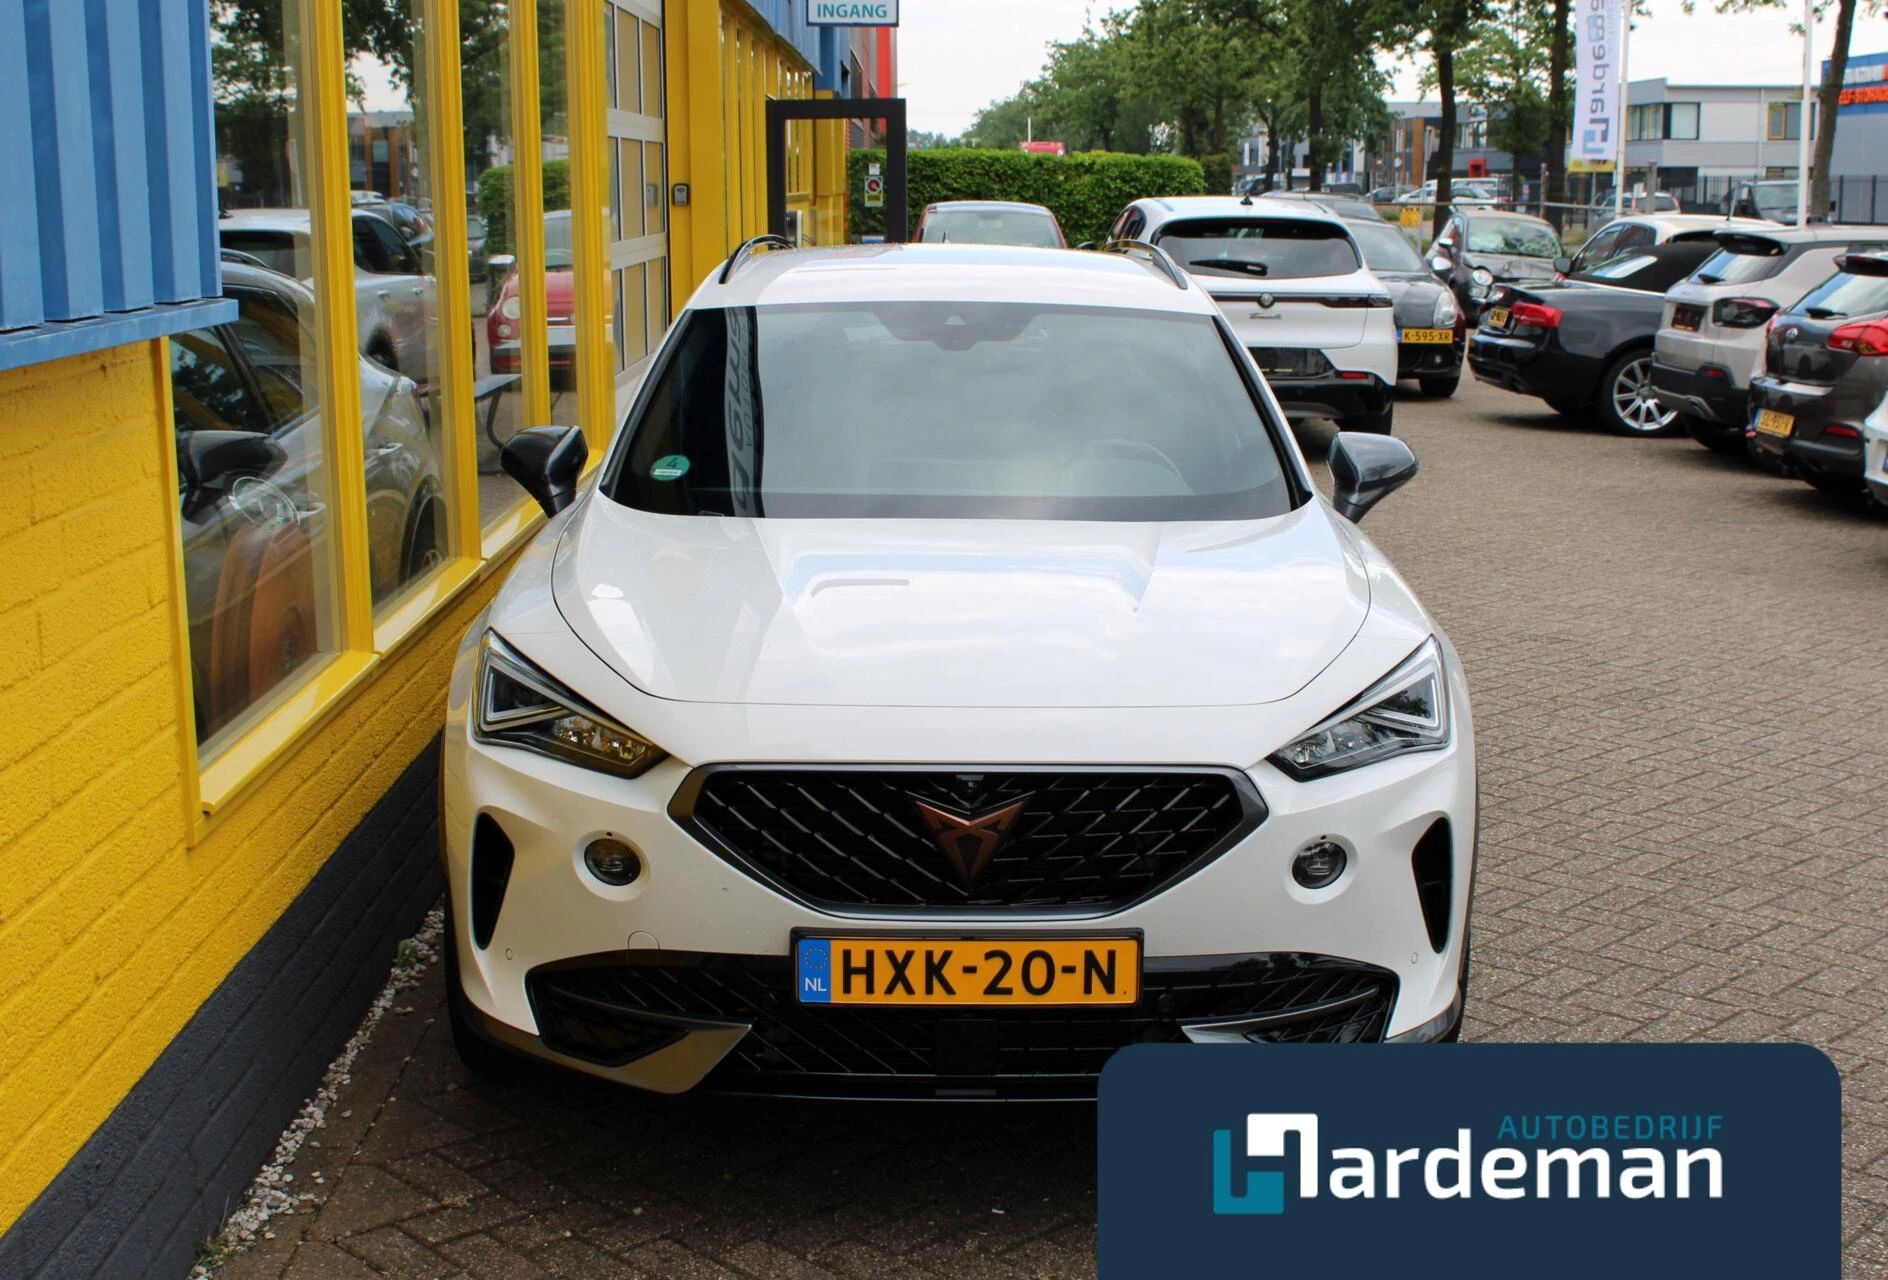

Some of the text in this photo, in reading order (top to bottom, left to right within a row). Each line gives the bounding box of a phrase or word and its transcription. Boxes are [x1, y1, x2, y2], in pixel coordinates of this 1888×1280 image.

[817, 3, 888, 18] INGANG
[1404, 331, 1450, 342] K-595-XR
[666, 457, 679, 469] 4
[804, 949, 1117, 996] NL HXK-20-N
